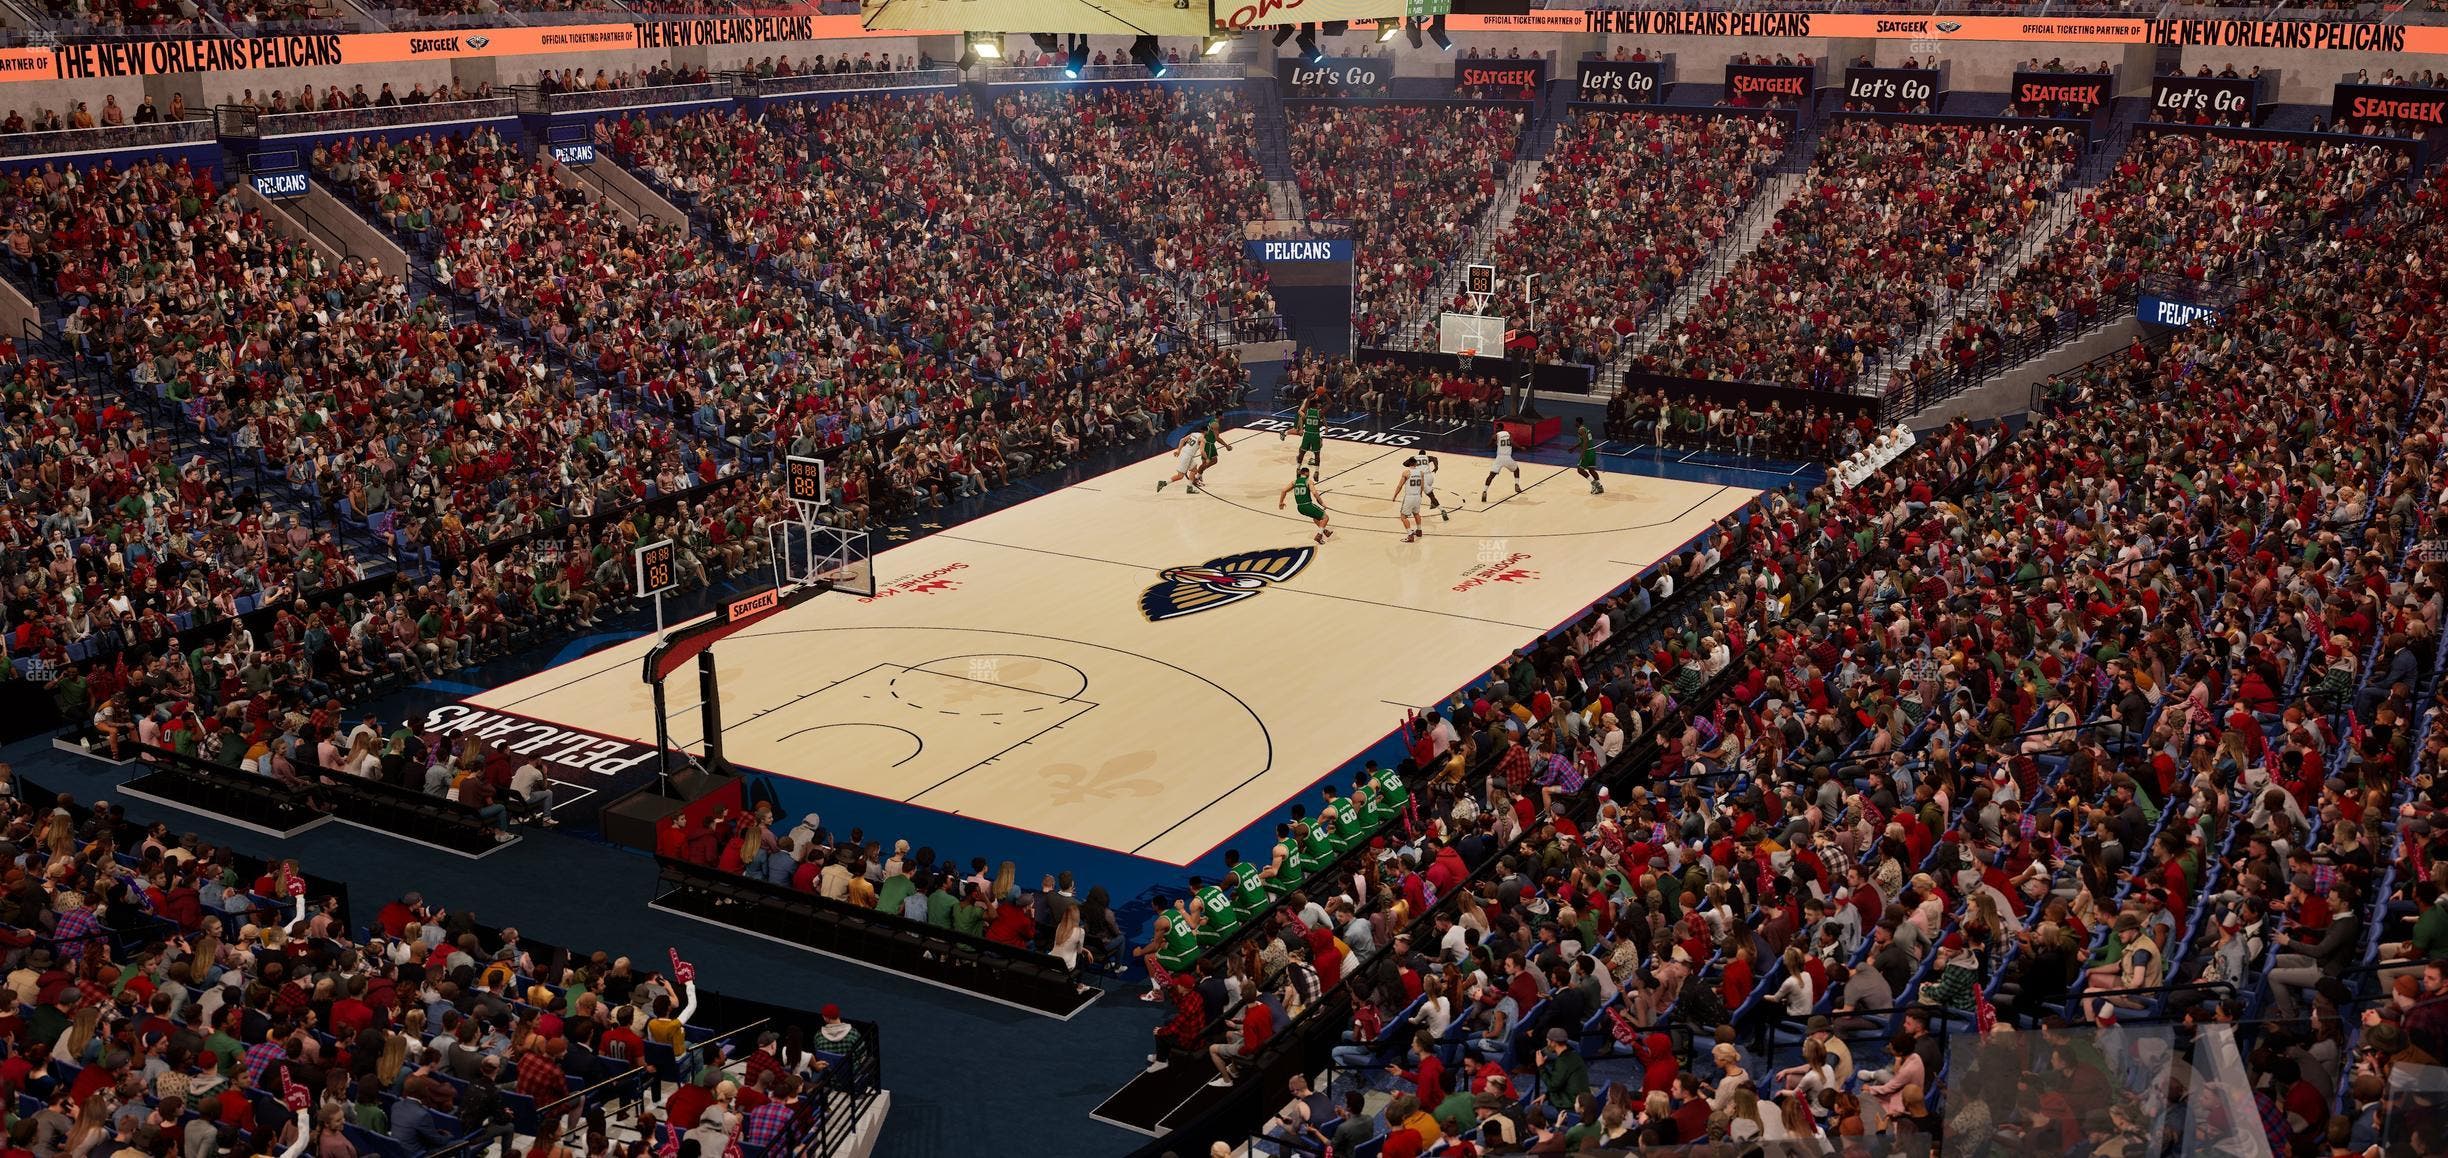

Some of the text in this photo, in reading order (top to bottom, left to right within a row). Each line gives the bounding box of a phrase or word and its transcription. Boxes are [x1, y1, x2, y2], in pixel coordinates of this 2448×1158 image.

[1483, 16, 1582, 25] OFFICIAL TICKETING PARTNER OF
[1585, 11, 1810, 37] THE NEW ORLEANS PELICANS
[1876, 20, 1928, 34] SEATGEEK
[2022, 24, 2141, 36] OFFICIAL TICKETING PARTNER OF
[541, 31, 633, 45] OFFICIAL TICKETING PARTNER OF
[633, 15, 812, 48] THE NEW ORLEANS PELICANS
[2144, 19, 2406, 52] THE NEW ORLEANS PELICANS
[410, 36, 460, 54] SEATGEEK
[36, 57, 48, 69] OF
[51, 35, 342, 79] THE NEW ORLEANS PELICANS
[1291, 67, 1375, 85] Let's Go
[1463, 68, 1536, 87] SEATGEEK
[1582, 70, 1653, 91] Let's Go
[1733, 74, 1804, 96] SEATGEEK
[1850, 78, 1930, 99] Let's Go
[2021, 83, 2101, 105] SEATGEEK
[2157, 87, 2209, 110] Let's
[2352, 96, 2446, 124] SEATGEEK
[555, 145, 593, 163] PELICANS
[257, 173, 306, 194] PELICANS
[1265, 242, 1331, 260] PELICANS
[1473, 278, 1488, 291] 88
[1243, 418, 1422, 447] PECANS
[791, 463, 817, 477] 88 88
[794, 476, 815, 497] 88
[649, 563, 669, 589] 88
[896, 562, 969, 589] SMOOTHIE
[733, 592, 775, 617] SEATGEEK
[402, 705, 659, 777] PELICANS
[1383, 774, 1404, 792] 00
[1340, 808, 1358, 825] 00
[1243, 873, 1262, 892] 00
[1207, 893, 1231, 913] 00
[609, 1039, 626, 1059] 00
